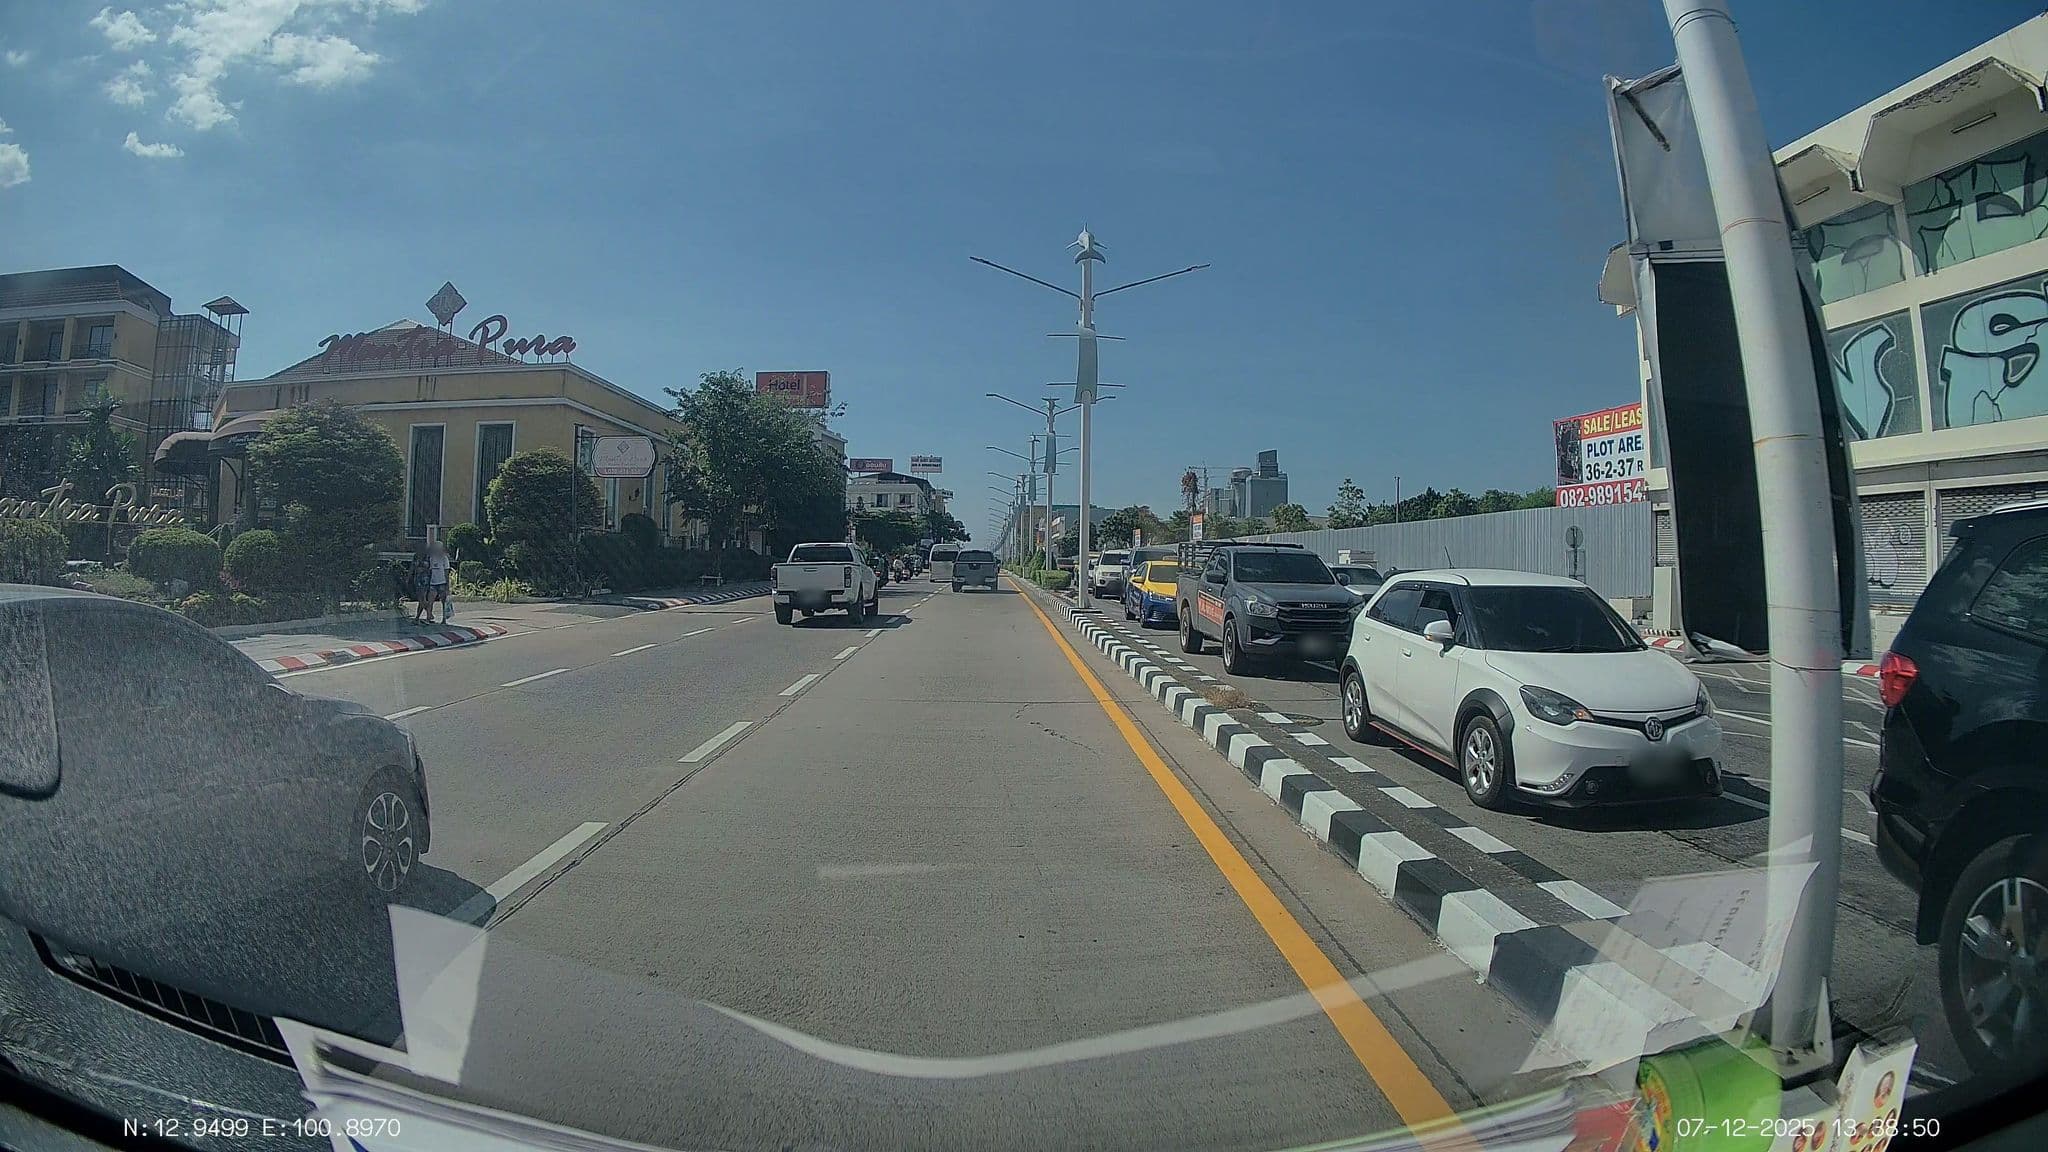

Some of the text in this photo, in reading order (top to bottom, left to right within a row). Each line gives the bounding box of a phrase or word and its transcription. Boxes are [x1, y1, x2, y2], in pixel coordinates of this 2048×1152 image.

[318, 314, 576, 362] Mantra Pura
[769, 379, 800, 390] Hotel
[1584, 407, 1642, 435] SALE/LEAS
[1587, 435, 1644, 458] PLOT ARE
[1586, 458, 1634, 480] 36-2-37
[0, 478, 184, 528] antra Pura
[1560, 481, 1645, 507] 082-989154
